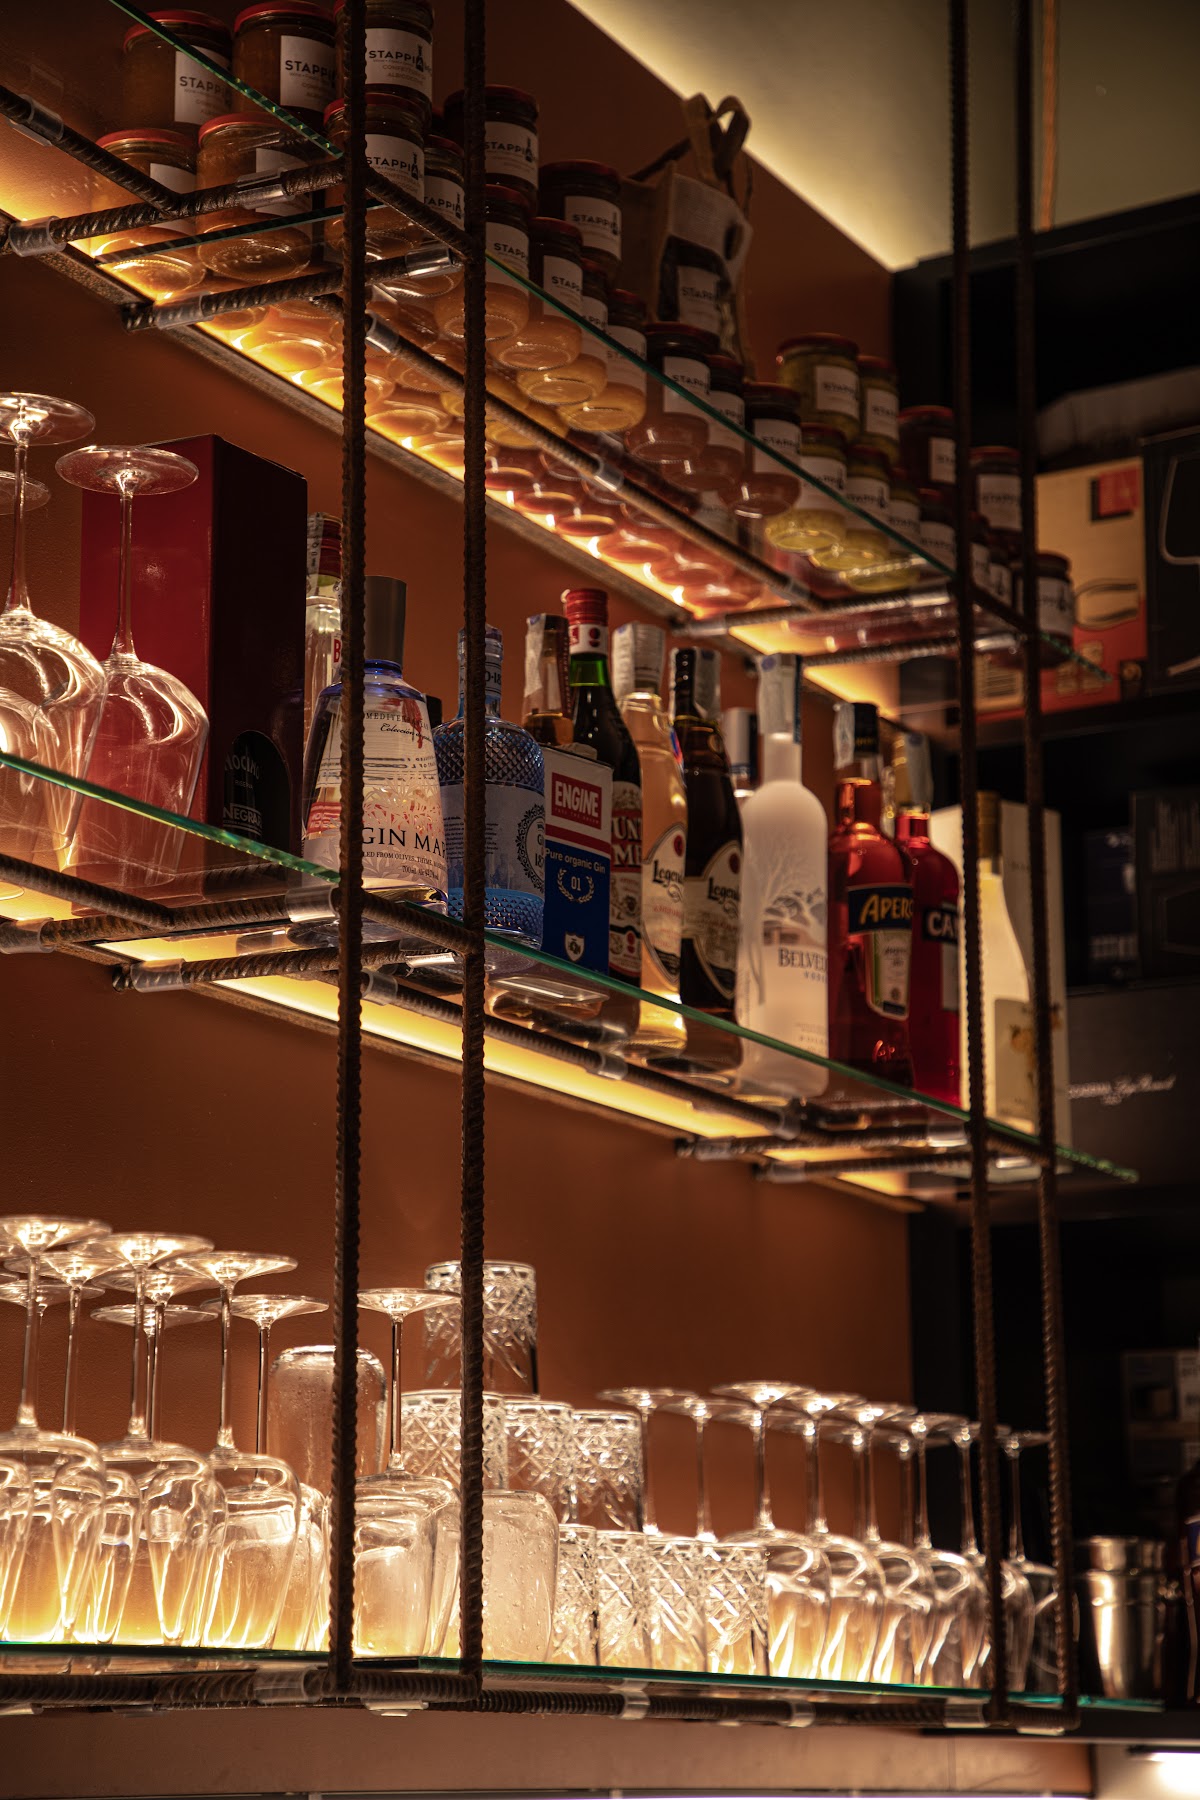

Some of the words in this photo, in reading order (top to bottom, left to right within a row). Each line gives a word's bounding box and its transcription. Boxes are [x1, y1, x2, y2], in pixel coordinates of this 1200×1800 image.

[424, 196, 455, 211] TAPPI
[554, 780, 600, 818] ENGINE
[361, 827, 406, 847] GIN
[545, 846, 563, 862] Pure
[564, 853, 592, 871] organic
[593, 860, 606, 874] Gin
[571, 876, 582, 892] 01
